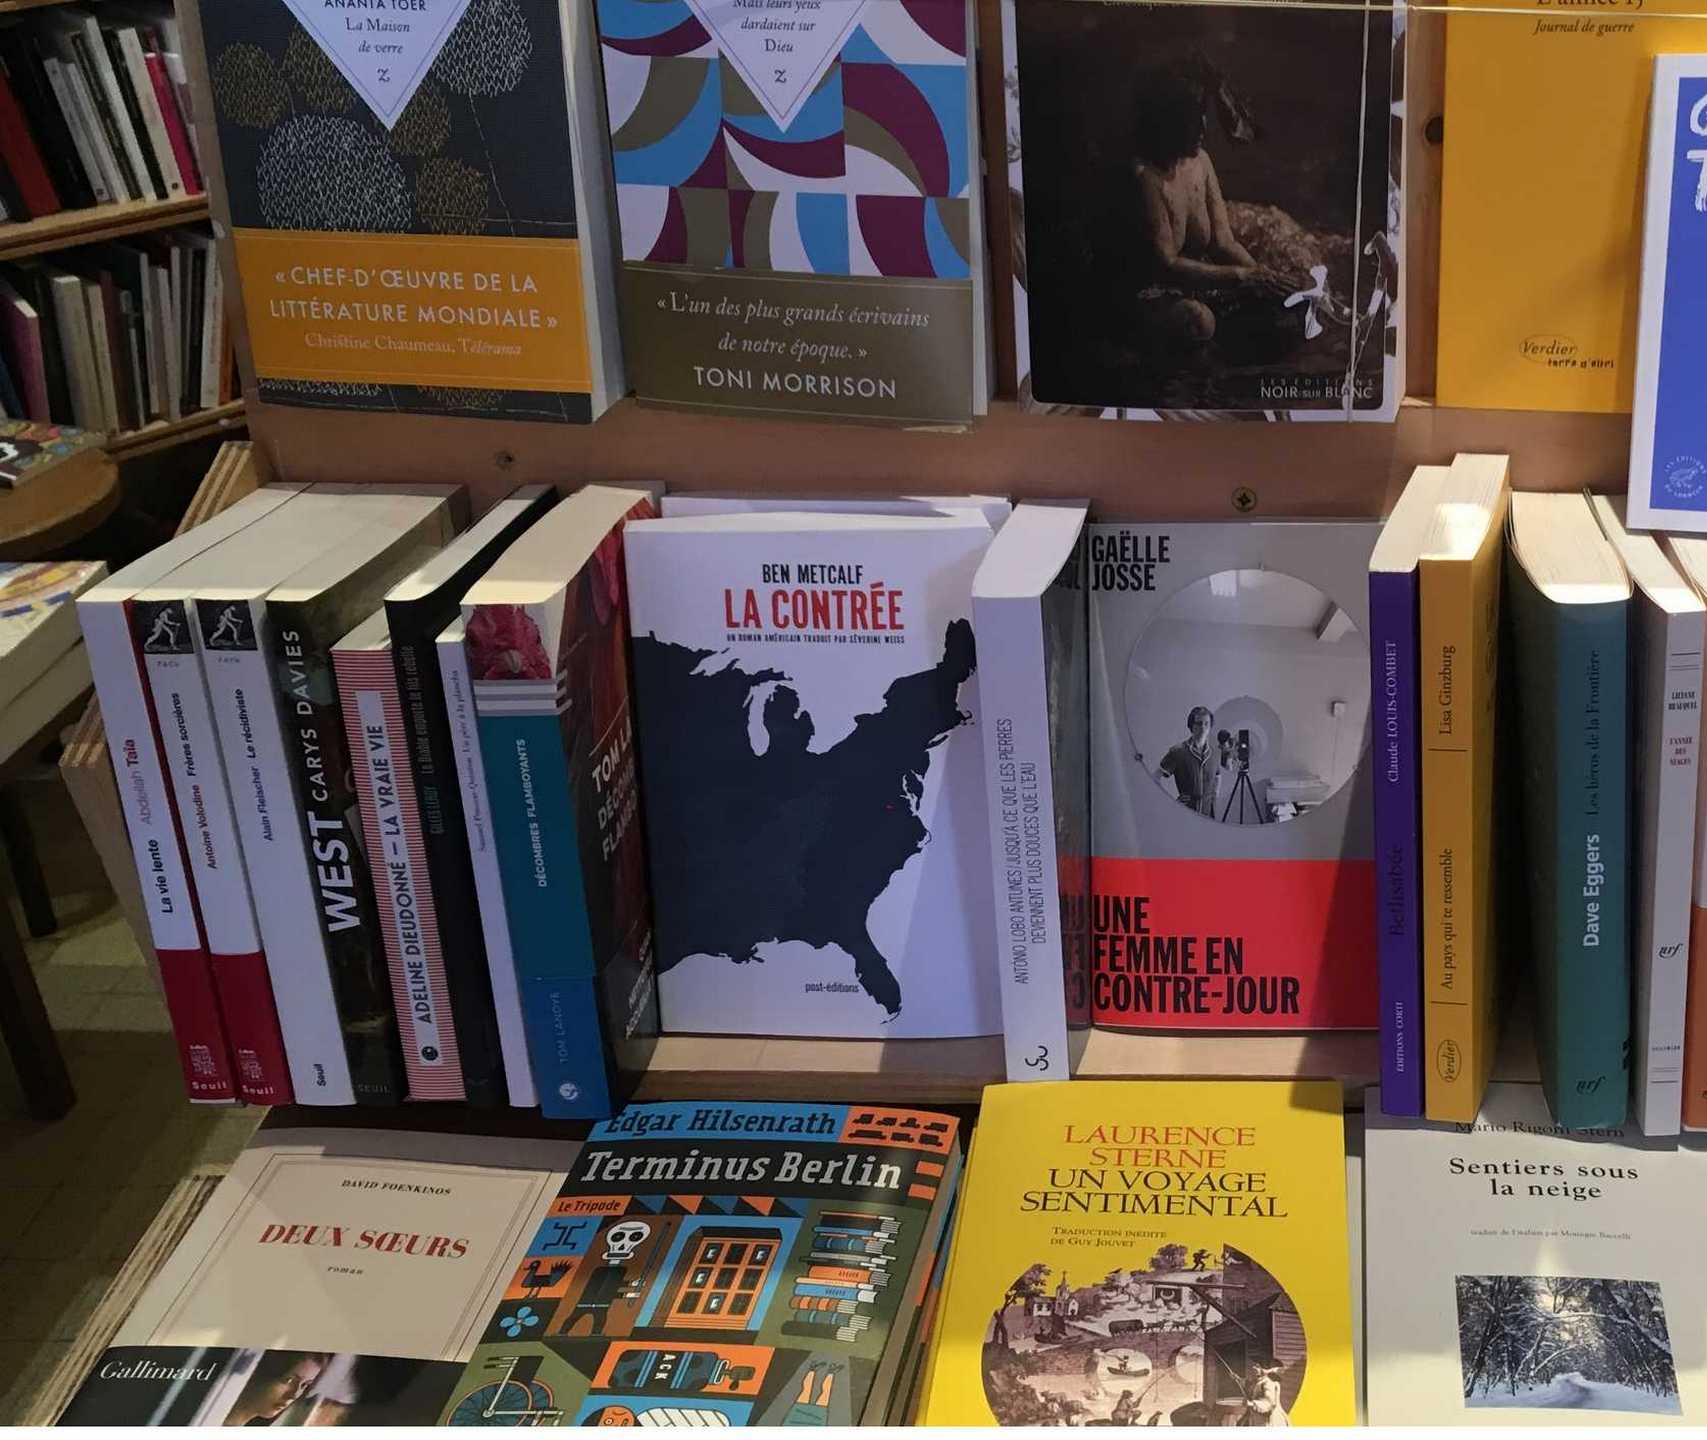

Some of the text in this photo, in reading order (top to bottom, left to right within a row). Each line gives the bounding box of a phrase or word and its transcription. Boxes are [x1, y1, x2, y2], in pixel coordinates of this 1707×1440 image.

[765, 38, 793, 52] Dieu
[474, 273, 537, 293] DE LA
[270, 298, 407, 322] LITTÉRATURE
[716, 296, 930, 328] des plus grands écrivains
[719, 331, 786, 354] de notre
[1523, 342, 1576, 355] Verdier
[694, 366, 896, 399] TONI MORRISON
[1091, 534, 1171, 564] GAËLLE
[762, 563, 863, 585] BEN METCALF
[1091, 564, 1157, 593] JOSSE
[725, 581, 904, 630] LA CONTRÉE
[285, 628, 313, 715] DAVIES
[1385, 640, 1397, 738] LOUIS-COMBET
[1438, 645, 1456, 736] Lisa Ginzburg
[305, 728, 328, 802] CARYS
[515, 738, 548, 888] DÉCOMBRES FLAMBOYANTS
[307, 809, 361, 934] WEST
[364, 725, 433, 1024] ADELINE DIEUDONNÉ LA VRAIE VIE
[1583, 833, 1604, 947] Dave Eggers
[1094, 896, 1150, 935] UNE
[1092, 936, 1244, 974] FEMME EN
[1092, 974, 1301, 1015] CONTRE-JOUR
[684, 1106, 837, 1137] Hilsenrath
[1063, 1124, 1257, 1148] LAURENCE
[578, 1149, 902, 1191] Terminus Berlin
[1089, 1148, 1227, 1169] STERNE
[1448, 1157, 1640, 1181] Sentiers sous
[380, 1181, 452, 1198] FOENKINOS
[1047, 1170, 1268, 1194] UN VOYAGE
[1489, 1179, 1603, 1203] la neige
[1019, 1191, 1288, 1218] SENTIMENTAL
[258, 1223, 470, 1261] DEUX SŒURS
[99, 1359, 215, 1386] Gallimard
